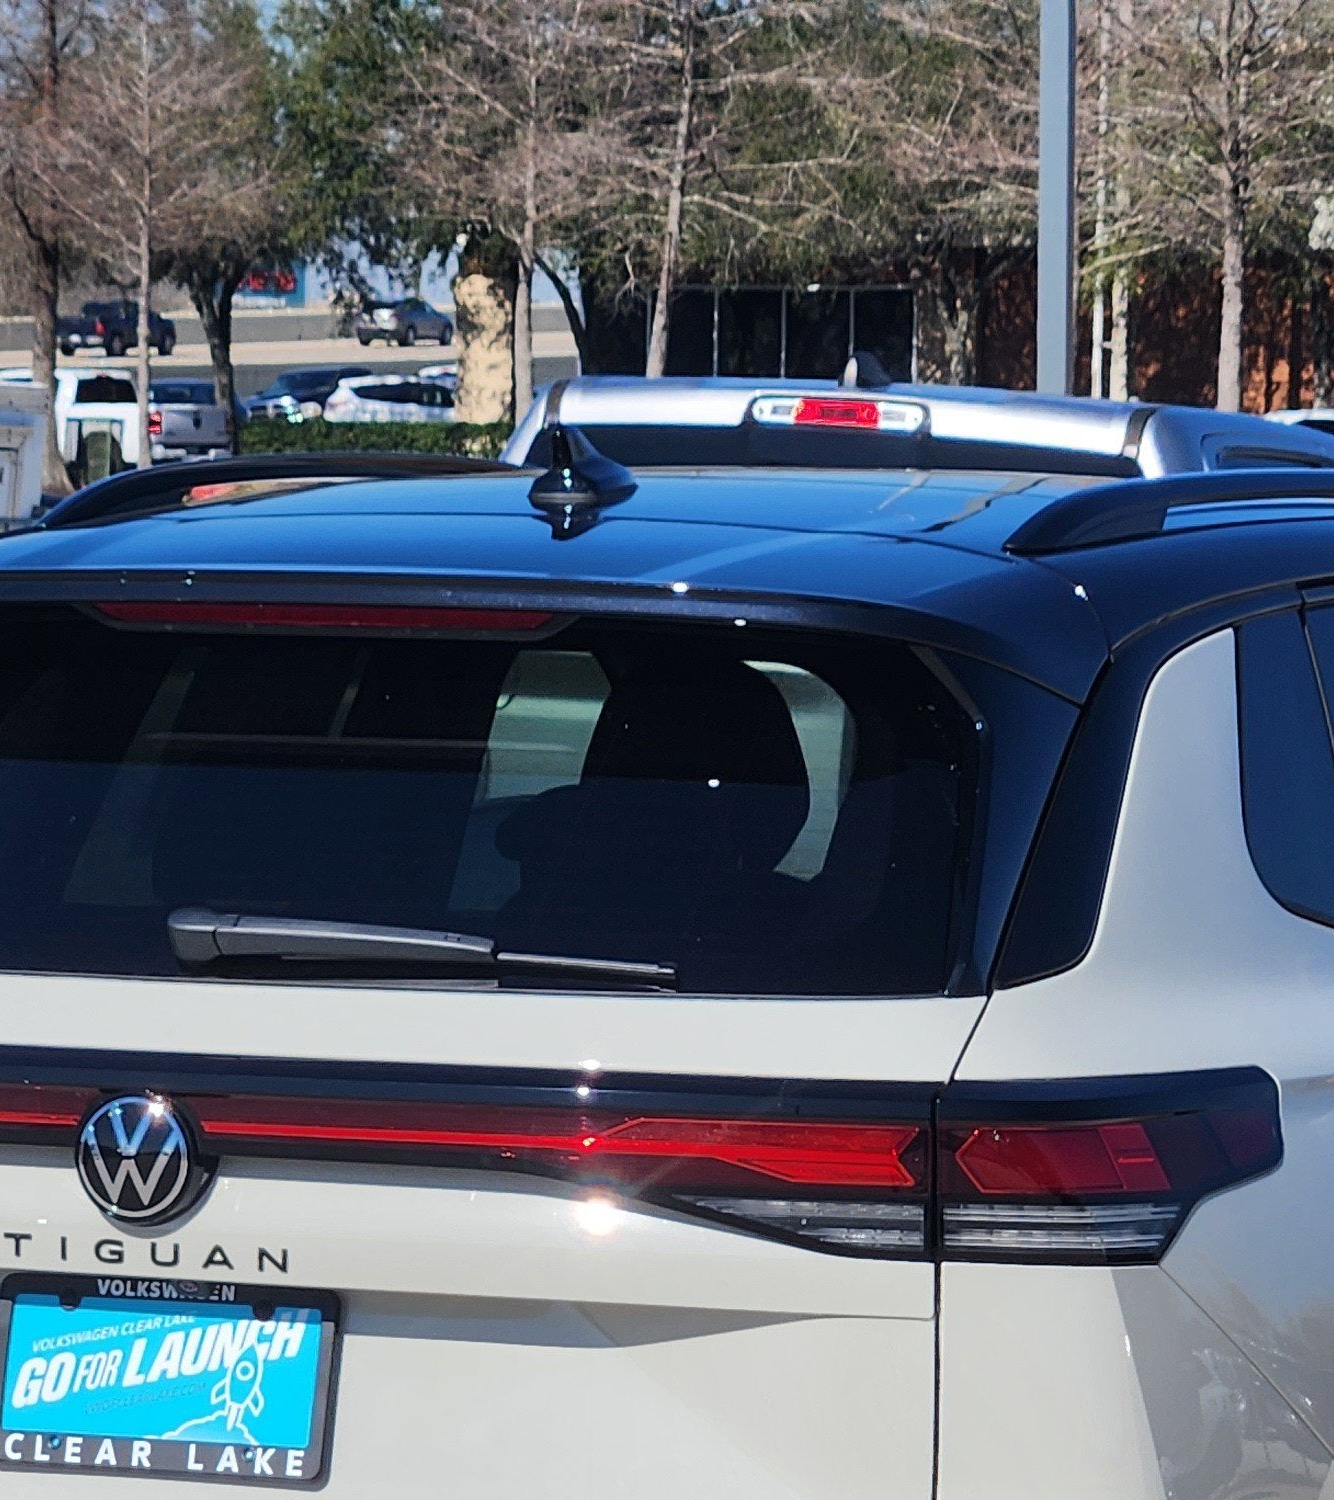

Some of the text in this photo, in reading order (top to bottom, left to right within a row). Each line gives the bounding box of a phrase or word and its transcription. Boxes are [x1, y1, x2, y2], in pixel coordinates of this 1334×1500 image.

[3, 1231, 290, 1274] TIGUAN
[96, 1278, 236, 1302] VOLKSWEN
[31, 1324, 120, 1353] VOLKSWAGEN
[120, 1315, 164, 1337] CLEAR
[11, 1307, 312, 1409] GO FOR LAUNCH
[3, 1432, 306, 1478] CLEAR LAKE
